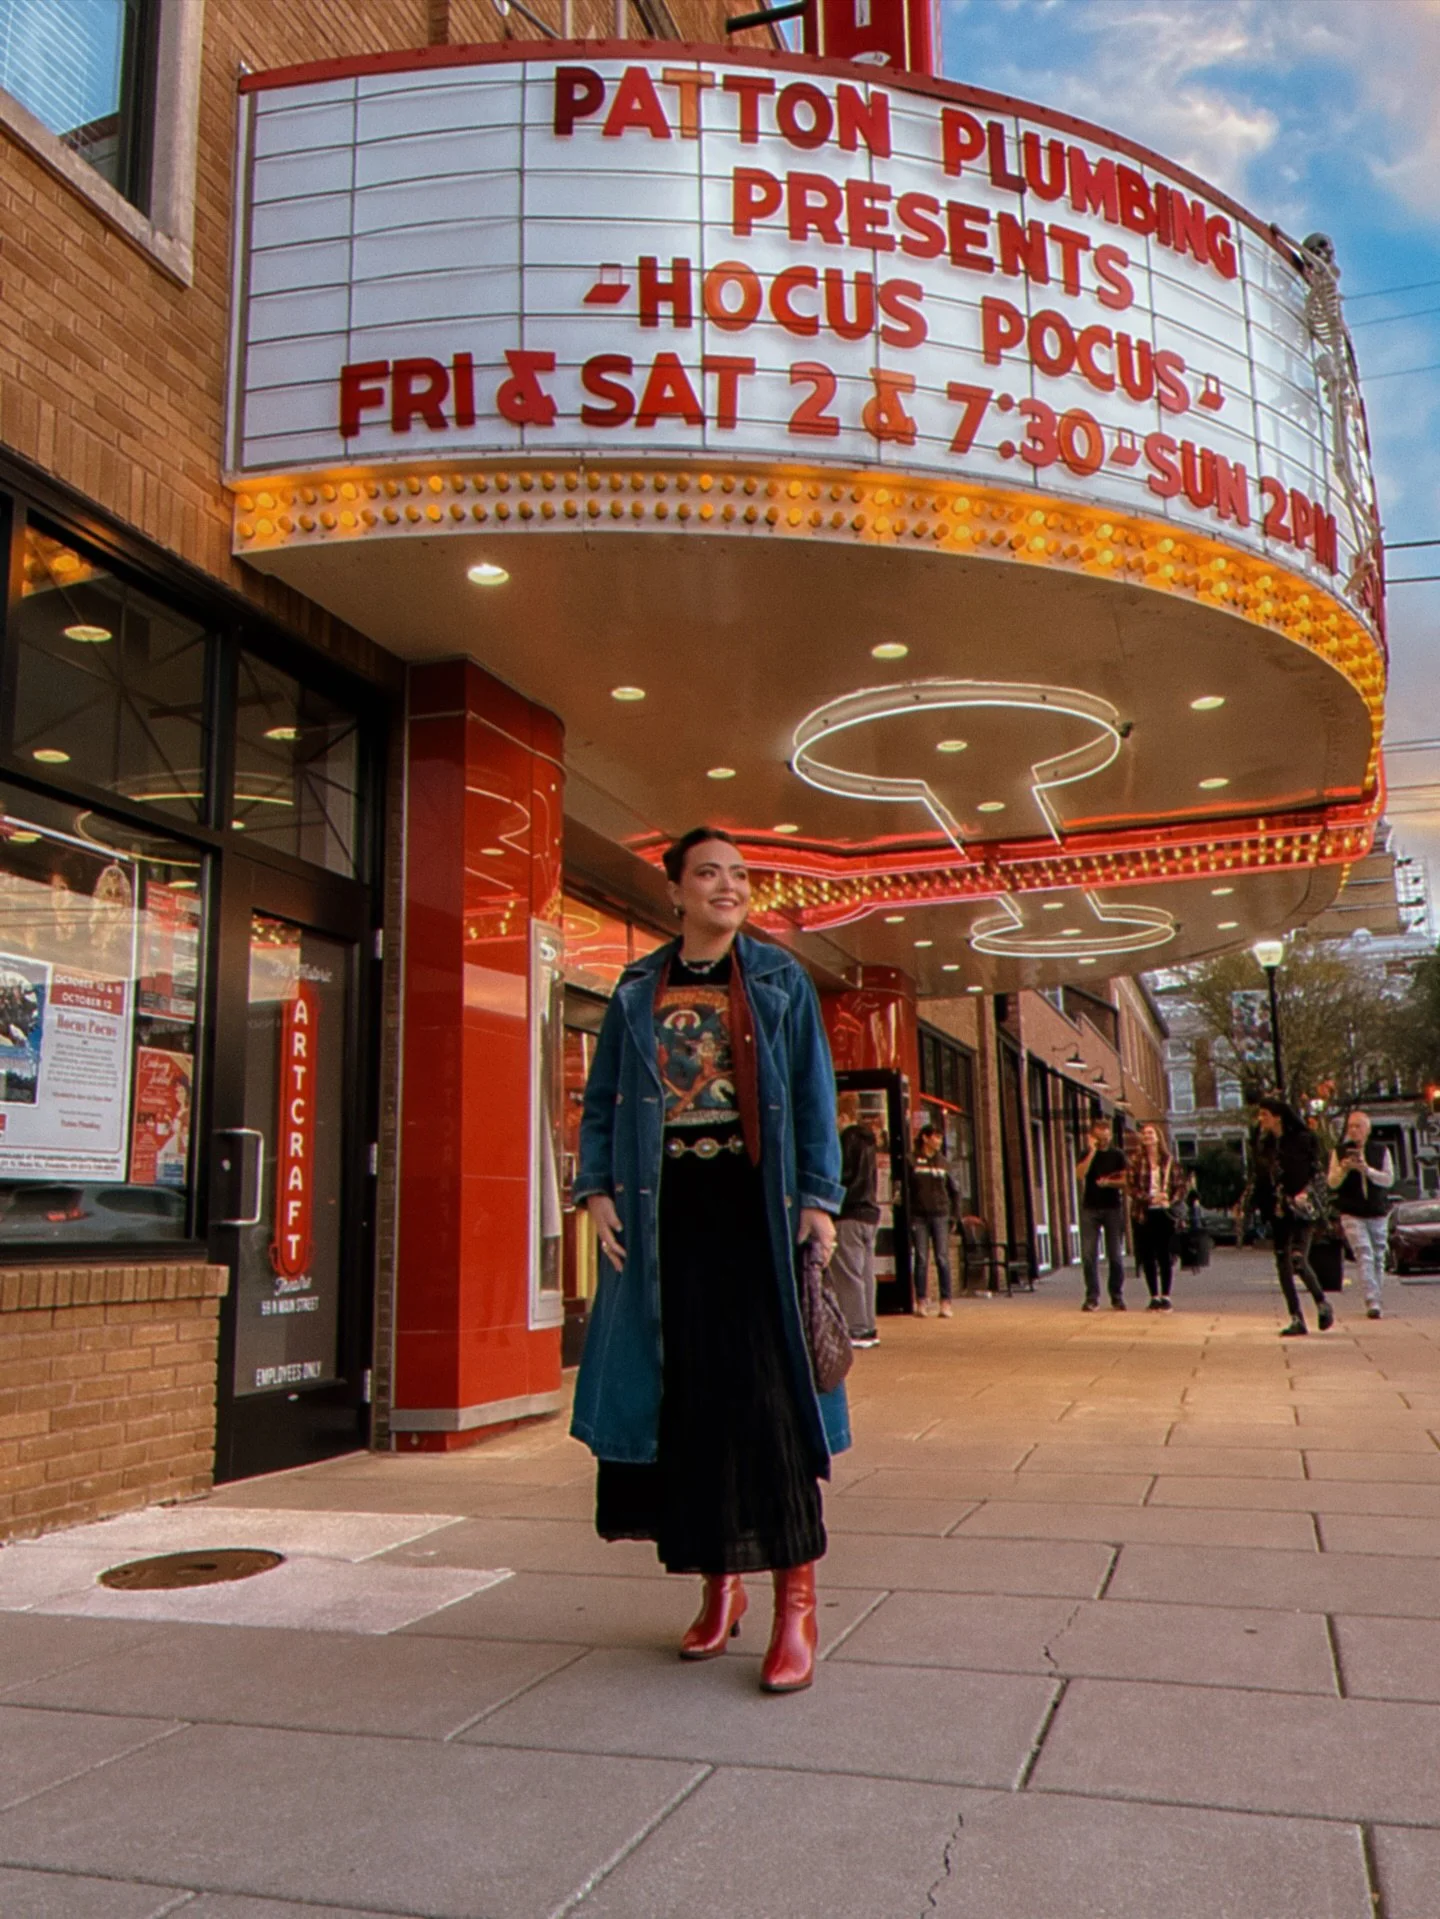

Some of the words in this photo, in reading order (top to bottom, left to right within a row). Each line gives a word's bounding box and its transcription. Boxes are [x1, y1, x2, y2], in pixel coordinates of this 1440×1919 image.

[557, 68, 890, 160] PATTON
[941, 108, 1236, 280] PLUMBING
[731, 168, 1133, 311] PRESENTS
[638, 257, 926, 348] HOCUS
[981, 297, 1189, 414] POCUS
[339, 353, 474, 438] FRI
[496, 350, 556, 427] &
[580, 353, 755, 430] SAT
[788, 362, 839, 437] 2
[861, 369, 916, 446] &
[946, 382, 1104, 477] 7:30
[1143, 432, 1250, 528] SUN
[62, 992, 101, 1007] OCTOBER
[286, 999, 309, 1262] ARTCRAFT
[256, 1363, 302, 1387] EMPLOYEES
[303, 1361, 322, 1379] ONLY
[296, 1296, 319, 1312] STREET
